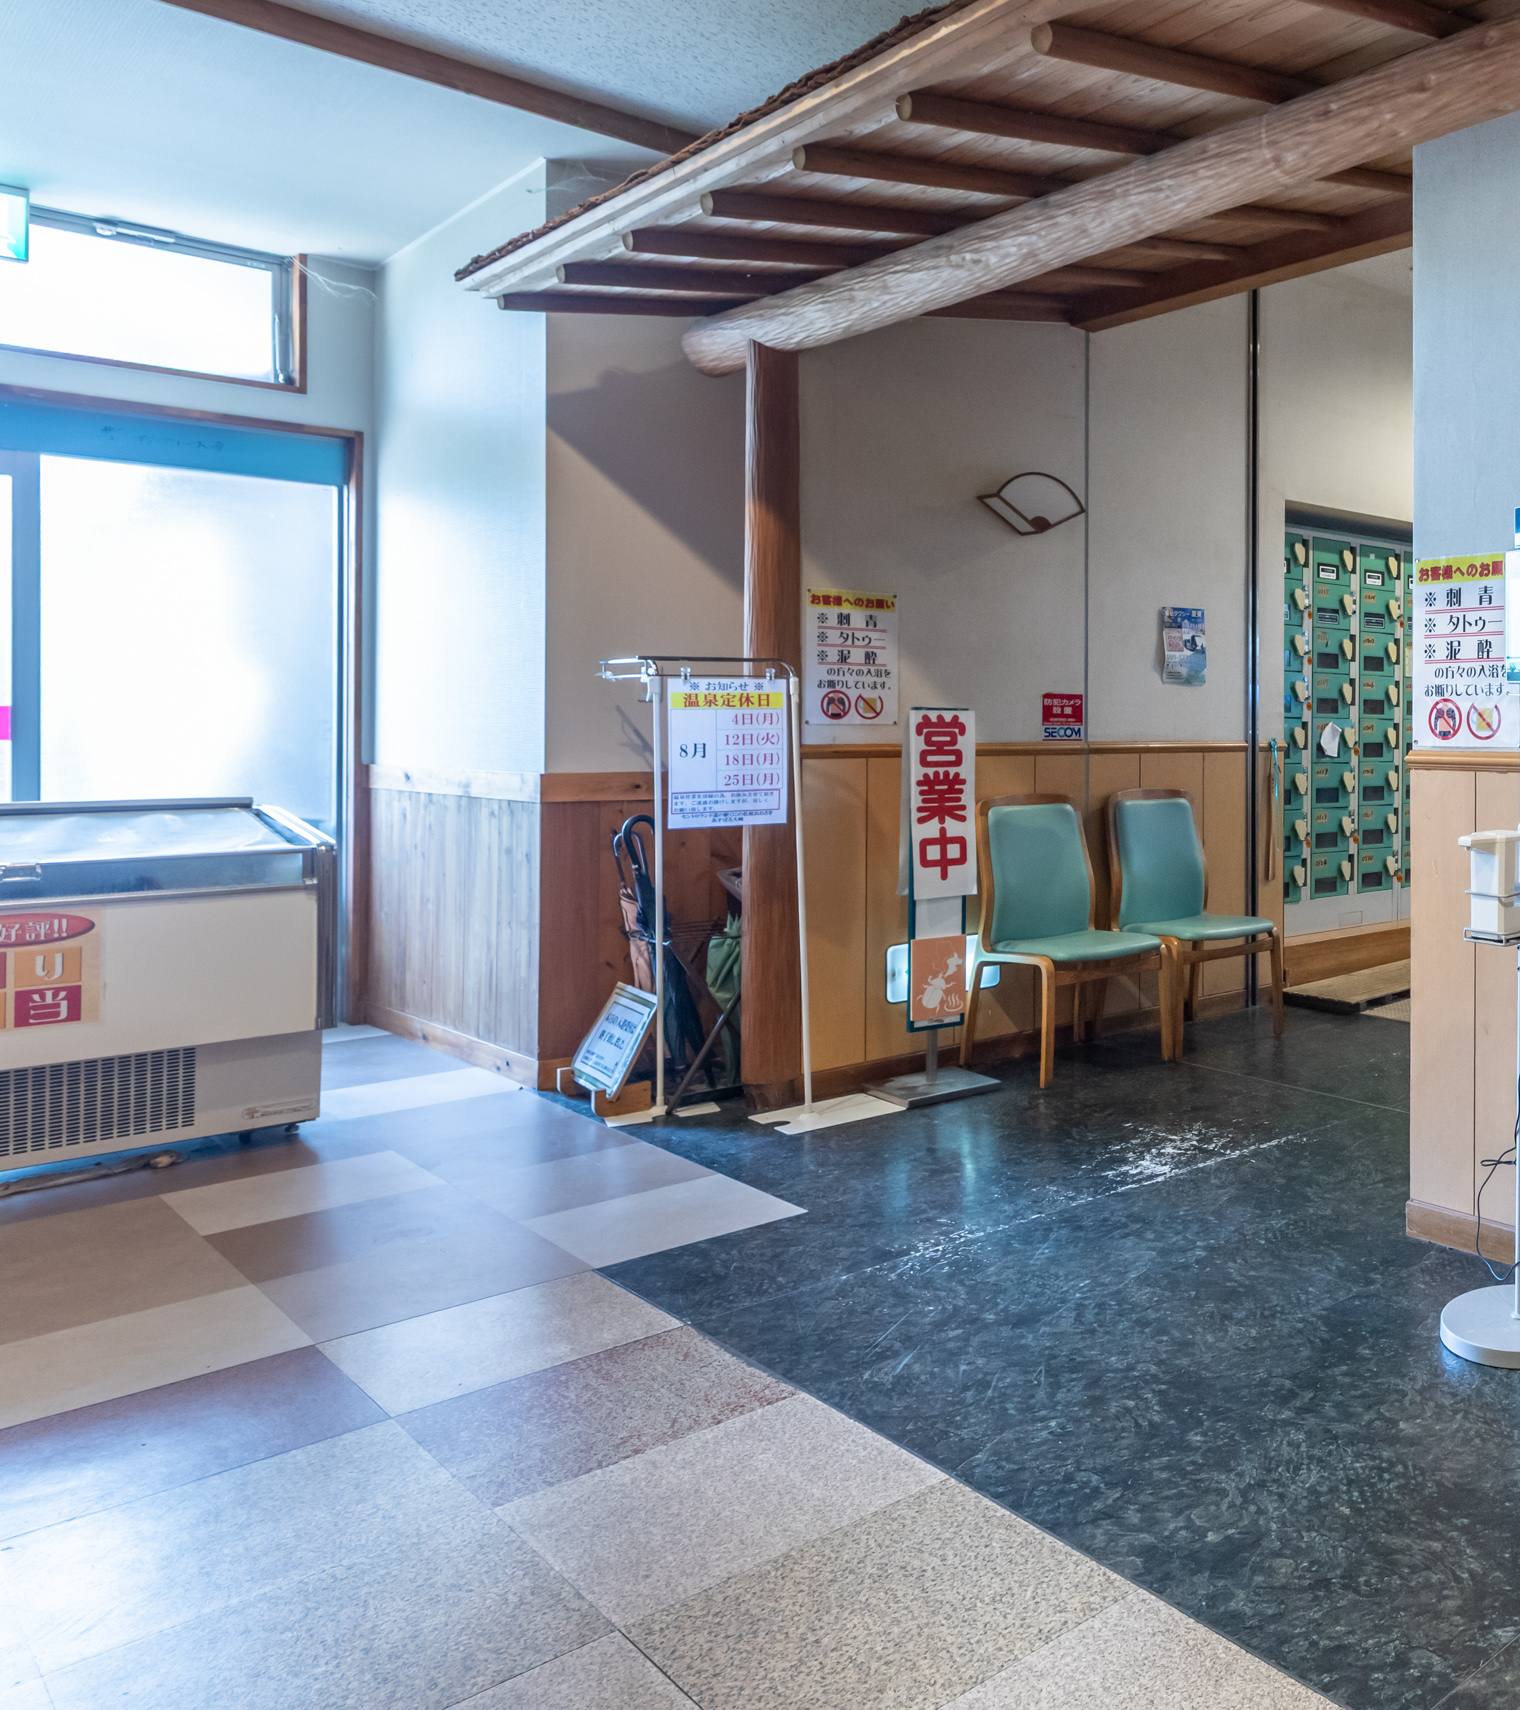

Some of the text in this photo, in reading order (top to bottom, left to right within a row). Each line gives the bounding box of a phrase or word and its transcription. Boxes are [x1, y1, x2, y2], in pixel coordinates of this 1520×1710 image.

[1418, 560, 1504, 583] お客様へのお願
[810, 594, 895, 610] お客様へのお願い
[1447, 614, 1503, 633] タトゥー
[839, 631, 886, 646] タトゥー
[827, 667, 892, 679] の方々の入浴を
[705, 681, 749, 692] お知らせ
[817, 679, 891, 690] お断りしています。
[1424, 682, 1510, 697] お断りしています。
[683, 693, 770, 708] 温泉定休日
[1044, 698, 1081, 706] 防犯カメラ
[1044, 727, 1081, 738] SECOM
[679, 742, 707, 759] 8月
[915, 713, 967, 881] 営業中
